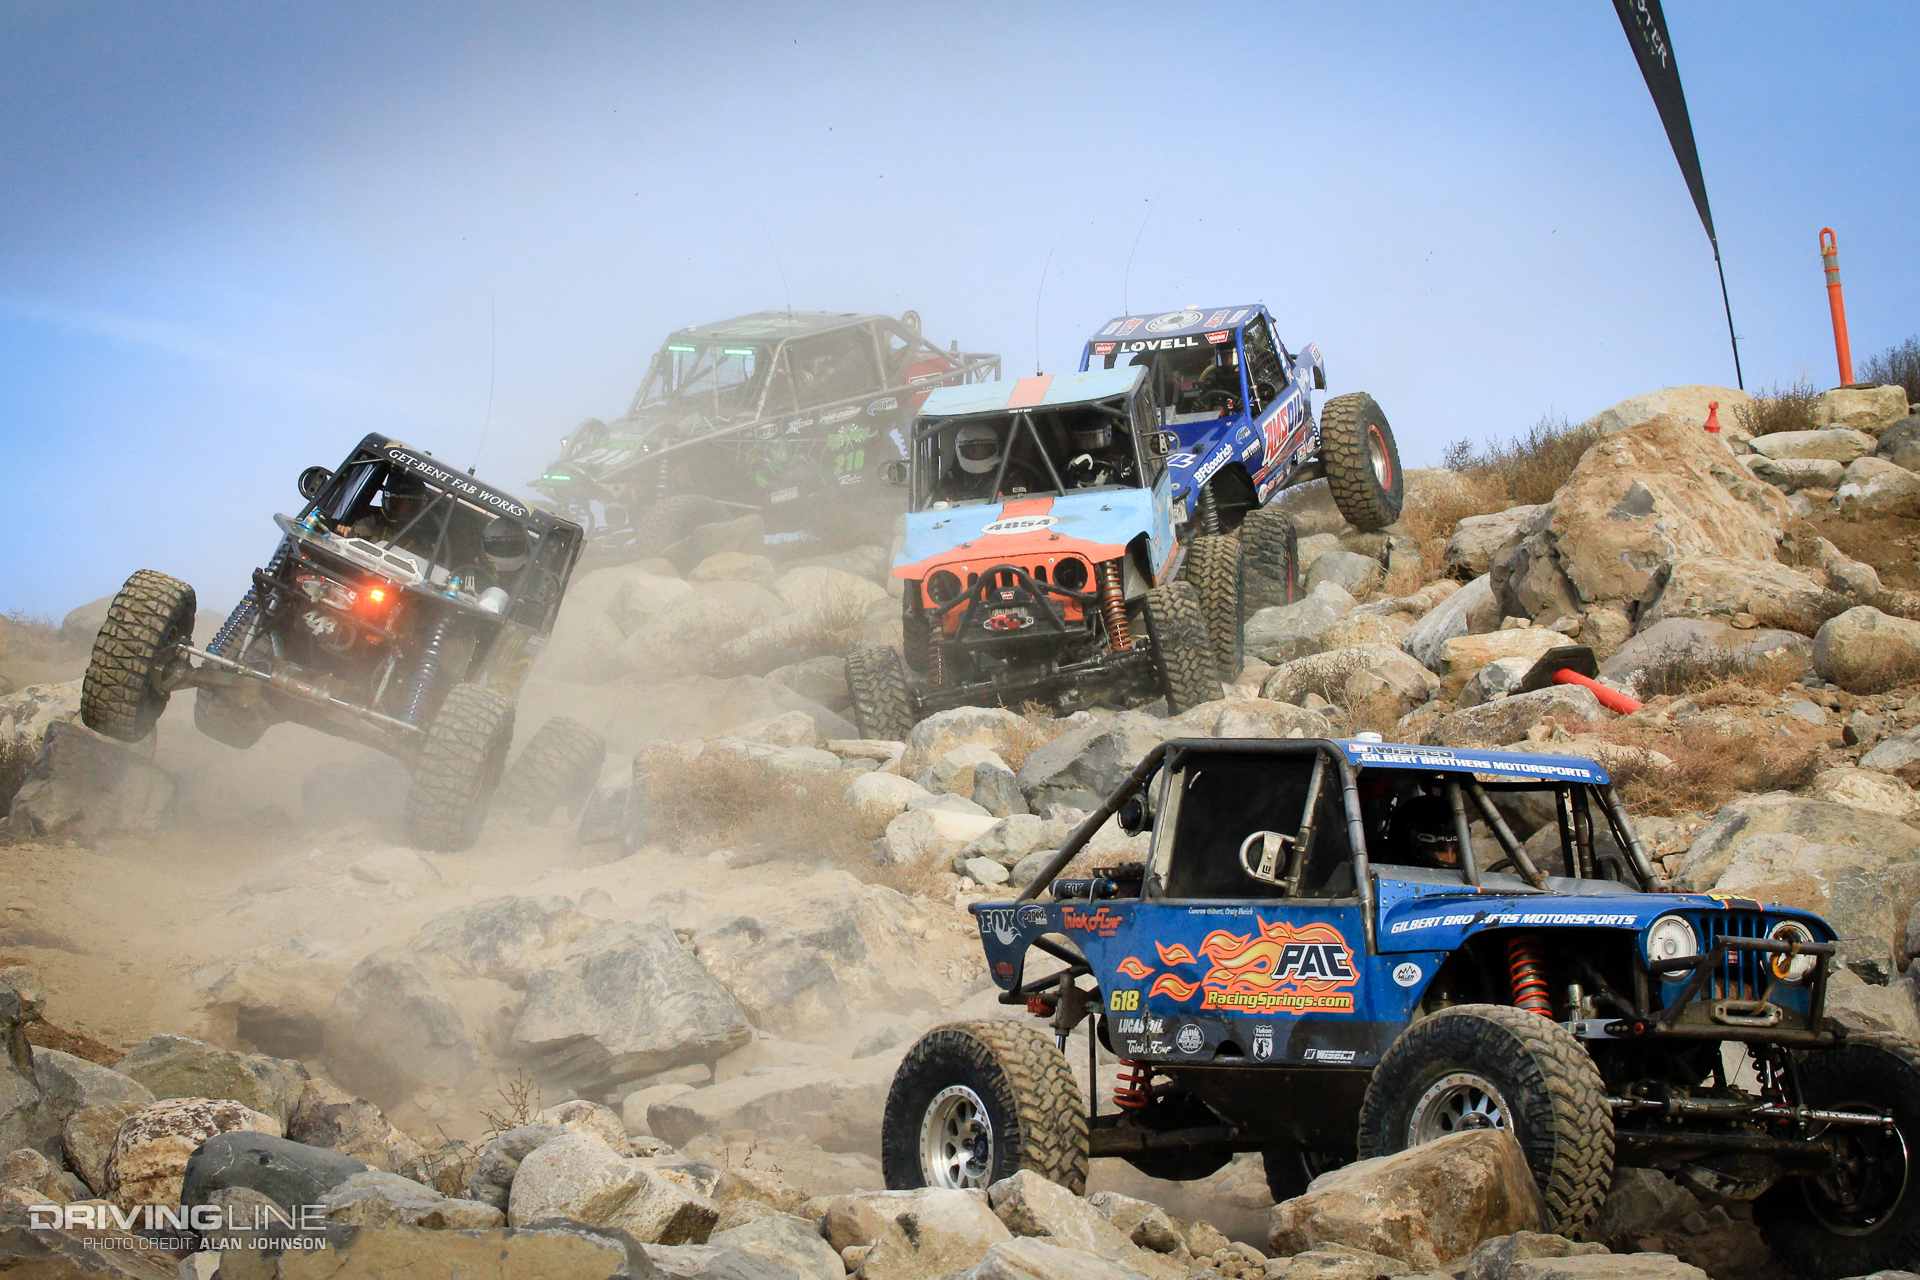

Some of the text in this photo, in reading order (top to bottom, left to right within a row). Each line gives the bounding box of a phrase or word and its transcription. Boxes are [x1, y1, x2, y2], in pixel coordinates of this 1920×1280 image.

[1120, 337, 1199, 353] LOVELL
[1262, 389, 1304, 467] AMSOIL
[834, 449, 865, 475] 218
[1193, 443, 1234, 484] BFGoodrich
[388, 449, 526, 517] GET-BENT FAB WORKS
[987, 518, 1051, 531] 4854
[302, 611, 338, 636] 444
[1361, 753, 1591, 778] GILBERT BROTHERS MOTORSPORTS
[981, 909, 1015, 933] FOX
[1391, 916, 1444, 934] GILBERT
[1520, 914, 1637, 925] MOTORSPORTS
[1272, 943, 1355, 980] PAC
[1110, 989, 1139, 1011] 618
[1208, 991, 1350, 1010] RacingSprings.com
[1117, 1018, 1145, 1034] LUCAS
[1316, 1049, 1356, 1060] WISECO
